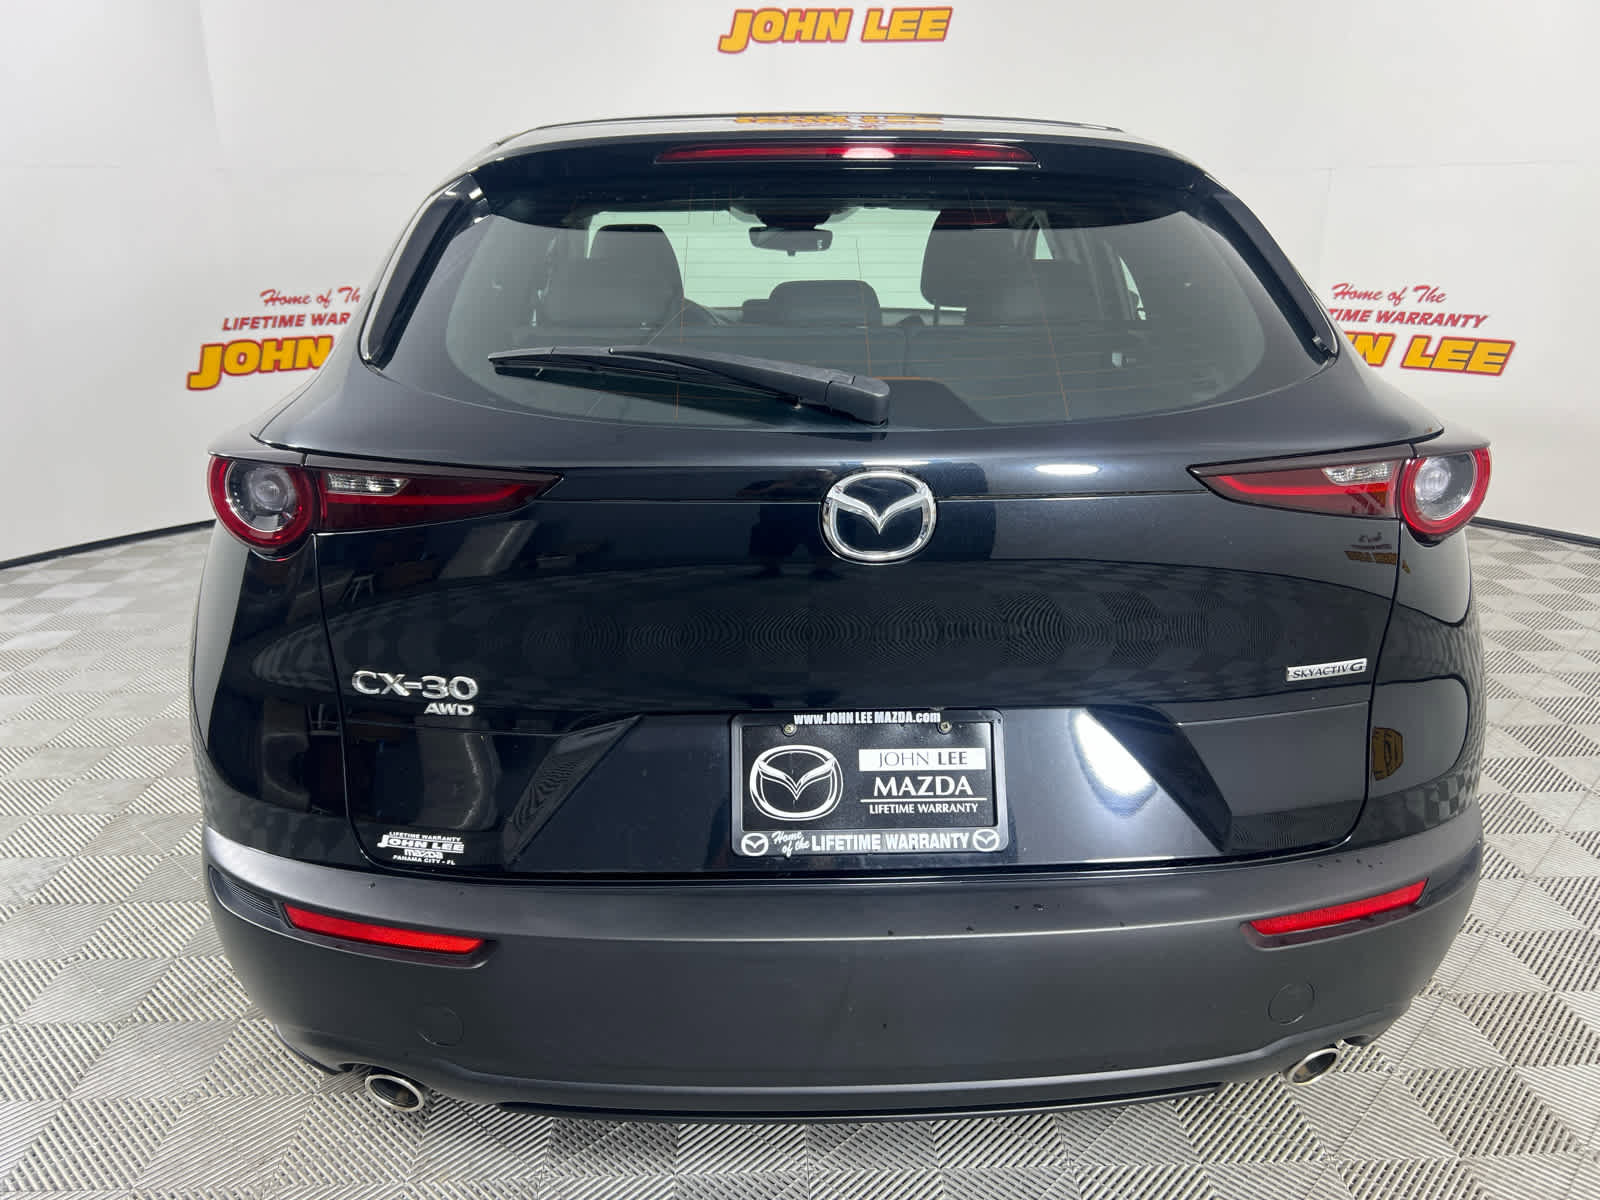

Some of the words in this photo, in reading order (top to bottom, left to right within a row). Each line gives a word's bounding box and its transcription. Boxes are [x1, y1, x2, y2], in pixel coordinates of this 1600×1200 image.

[718, 7, 853, 54] JOHN
[860, 6, 953, 42] LEE
[260, 288, 311, 306] Home
[316, 287, 332, 309] of
[337, 285, 361, 304] Th
[1331, 282, 1383, 301] Home
[1387, 286, 1407, 306] of
[1412, 284, 1447, 304] The
[222, 313, 306, 331] LIFETIME
[311, 312, 352, 327] WAR
[1327, 308, 1374, 323] TIME
[1375, 310, 1488, 328] WARRANTY
[186, 335, 335, 391] JOHN
[1400, 334, 1516, 377] LEE
[352, 670, 478, 700] CX-30
[424, 702, 474, 716] AWD
[794, 712, 854, 724] www.JOHN
[856, 712, 874, 723] LEE
[874, 711, 941, 723] MAZDA.com
[879, 751, 929, 768] JOHN
[937, 751, 968, 766] LEE
[873, 775, 973, 797] MAZDA
[869, 803, 915, 814] LIFETIME
[917, 802, 978, 813] WARRANTY
[377, 834, 428, 848] JOHN
[432, 842, 465, 853] LEE
[389, 831, 420, 839] LIFETIME
[421, 834, 461, 842] WARRANTY
[771, 831, 803, 845] Home
[811, 834, 881, 851] LIFETIME
[886, 832, 969, 851] WARRANTY
[782, 841, 793, 858] of
[795, 836, 810, 851] the
[393, 854, 422, 863] PANAMA
